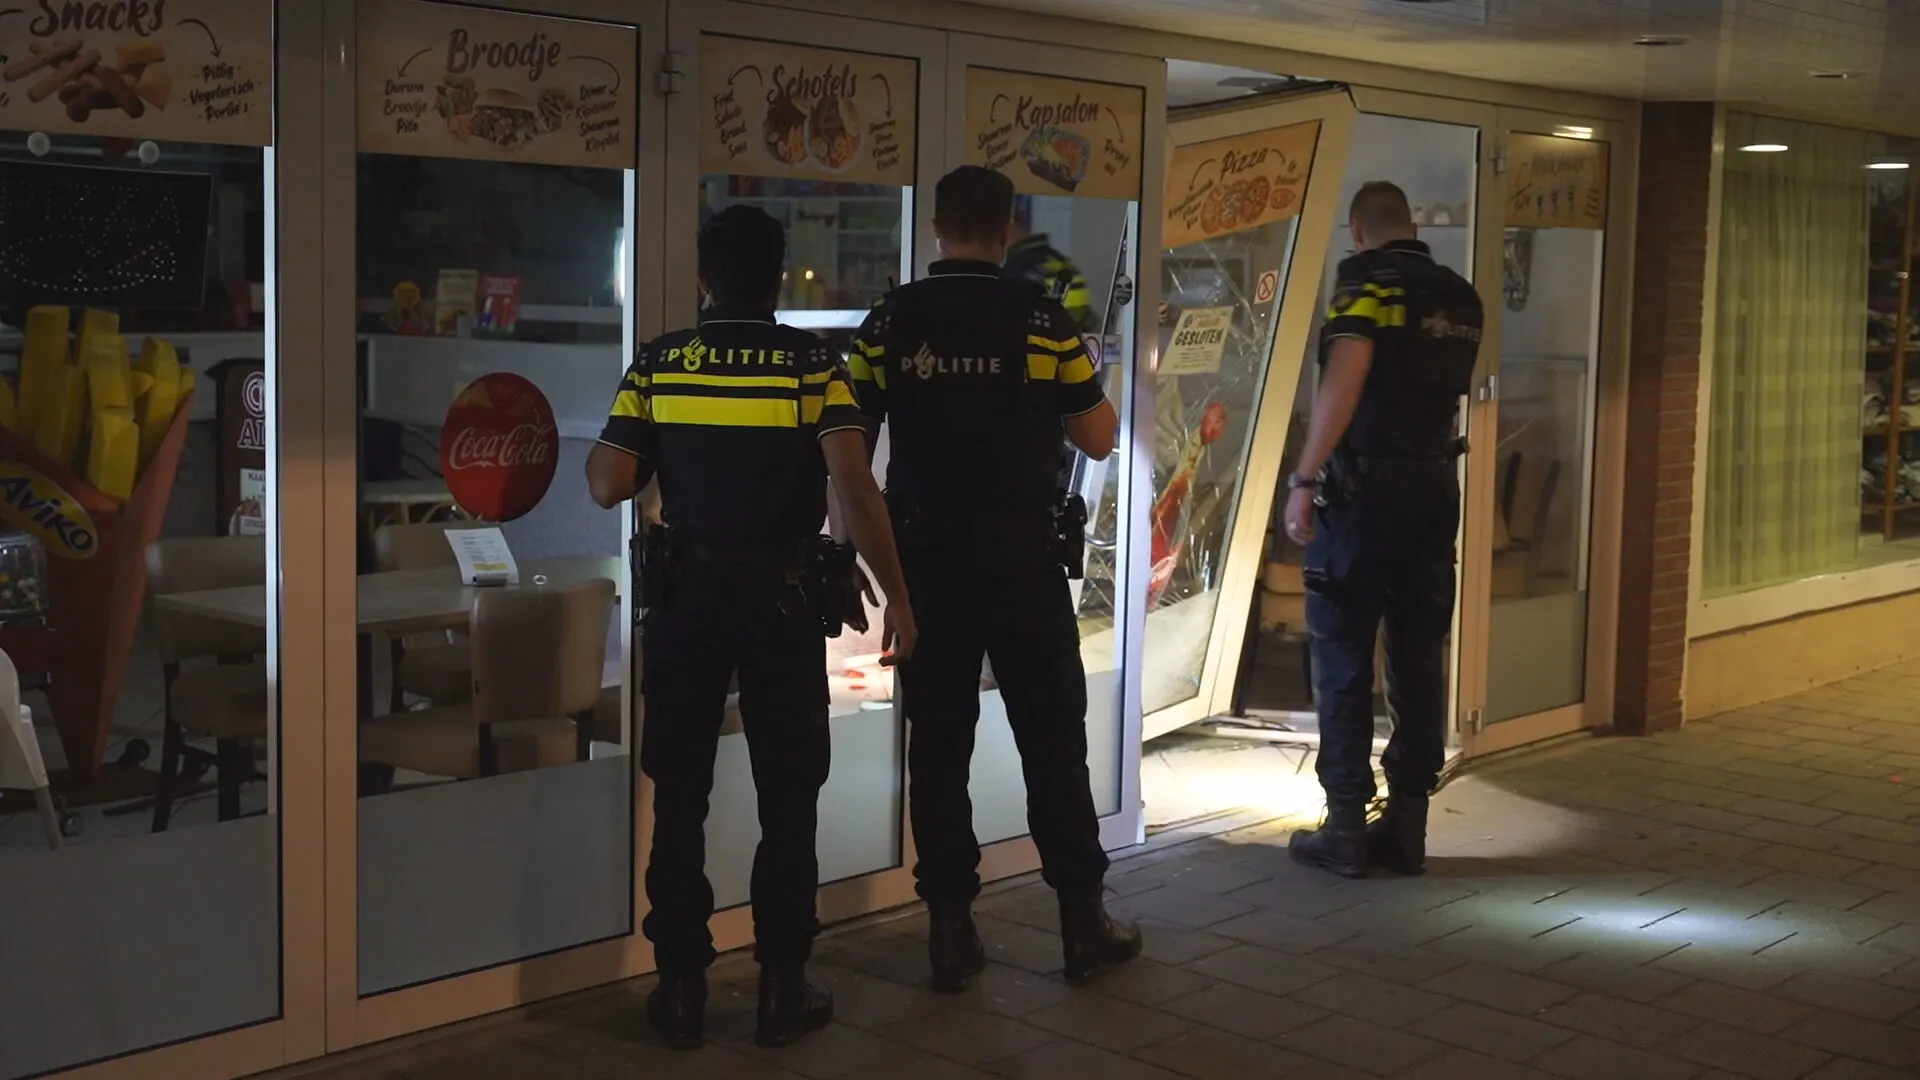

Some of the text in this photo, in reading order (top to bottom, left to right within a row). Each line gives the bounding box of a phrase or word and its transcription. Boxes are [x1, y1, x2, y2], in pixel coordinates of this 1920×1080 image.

[30, 0, 166, 37] Snacks
[446, 28, 562, 82] Broodje
[766, 63, 858, 104] Schotels
[383, 99, 429, 118] Broodje
[396, 118, 418, 135] Pita
[1015, 93, 1099, 136] Kapsalon
[1220, 147, 1269, 181] Pizza
[667, 336, 785, 372] POLITIE
[1175, 328, 1225, 346] GESLOTEN
[900, 342, 1001, 380] POLITIE
[449, 424, 552, 470] Coca-Cola
